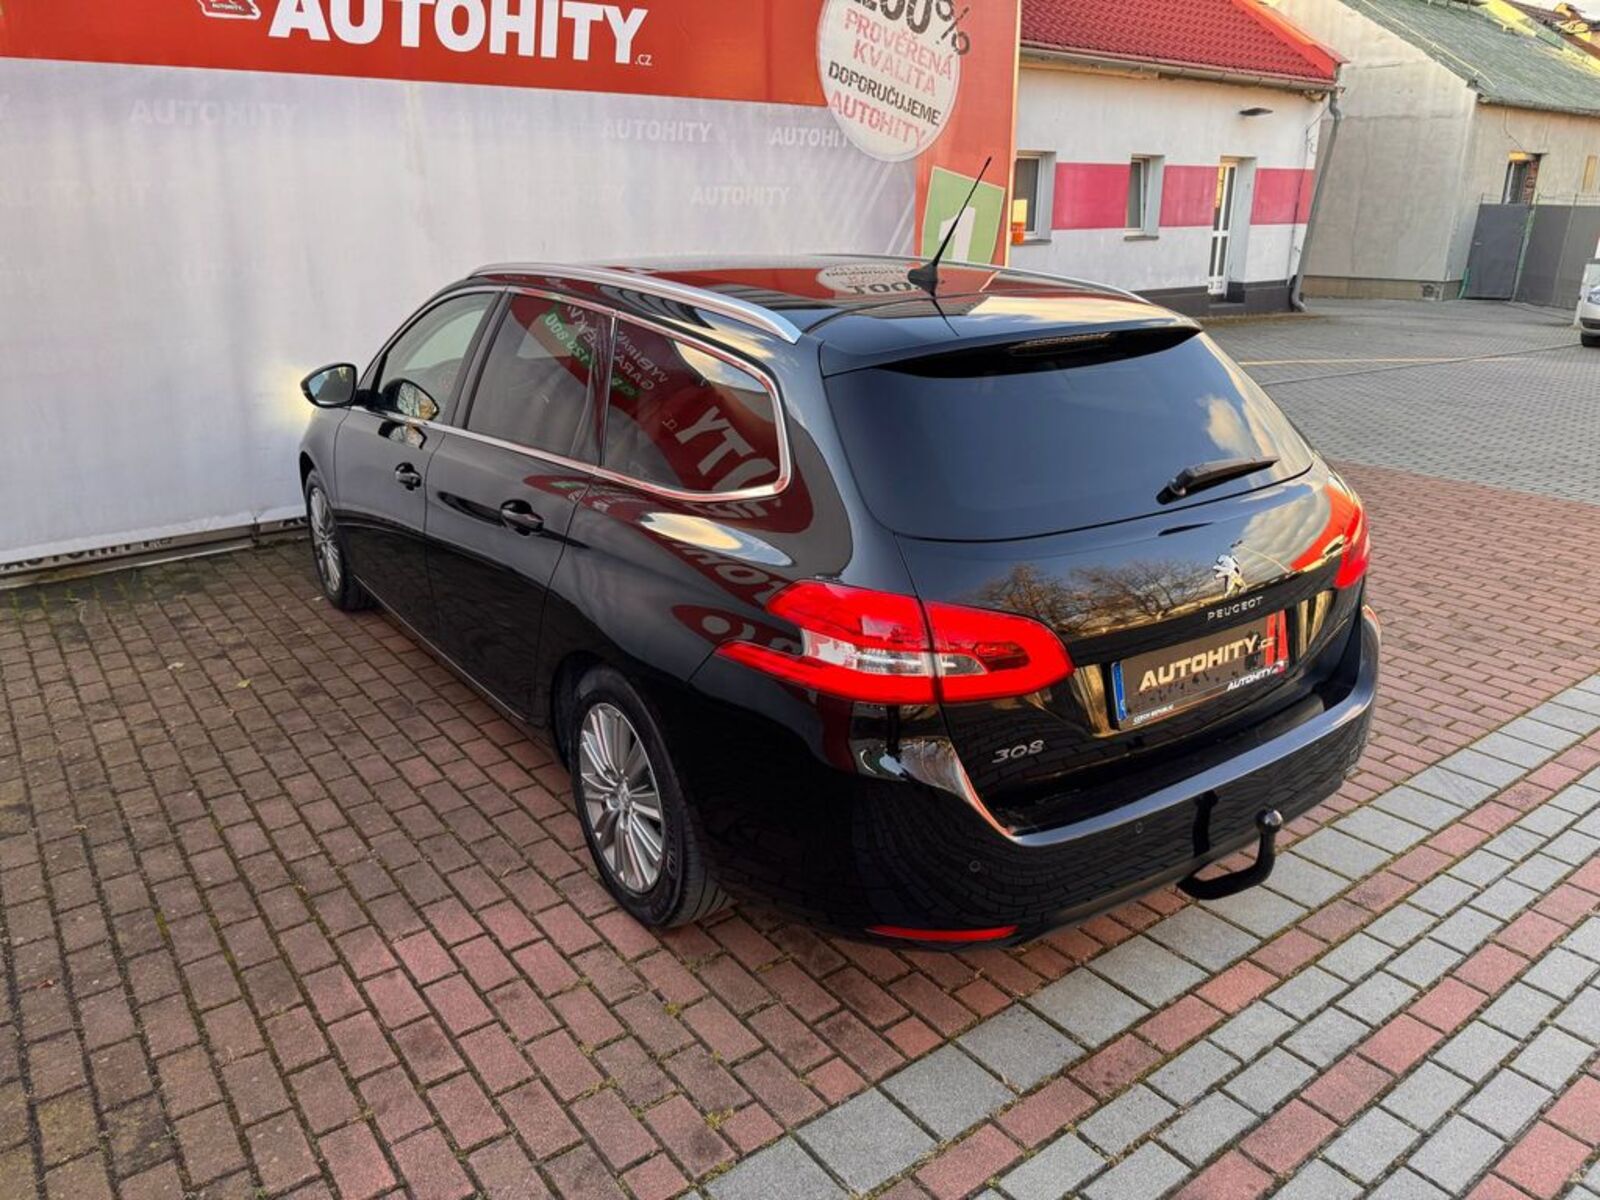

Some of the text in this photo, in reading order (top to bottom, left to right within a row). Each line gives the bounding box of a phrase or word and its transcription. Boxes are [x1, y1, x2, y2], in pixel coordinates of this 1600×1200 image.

[850, 0, 971, 55] 00%
[853, 39, 936, 97] KVALITA
[828, 60, 942, 127] DOPORUČUJEME
[129, 98, 298, 127] AUTOHITY
[829, 91, 926, 149] AUTOHITY
[604, 118, 713, 143] AUTOHITY
[692, 186, 790, 206] AUTOHITY
[1207, 596, 1264, 621] PEUGEOT
[991, 740, 1044, 764] 308
